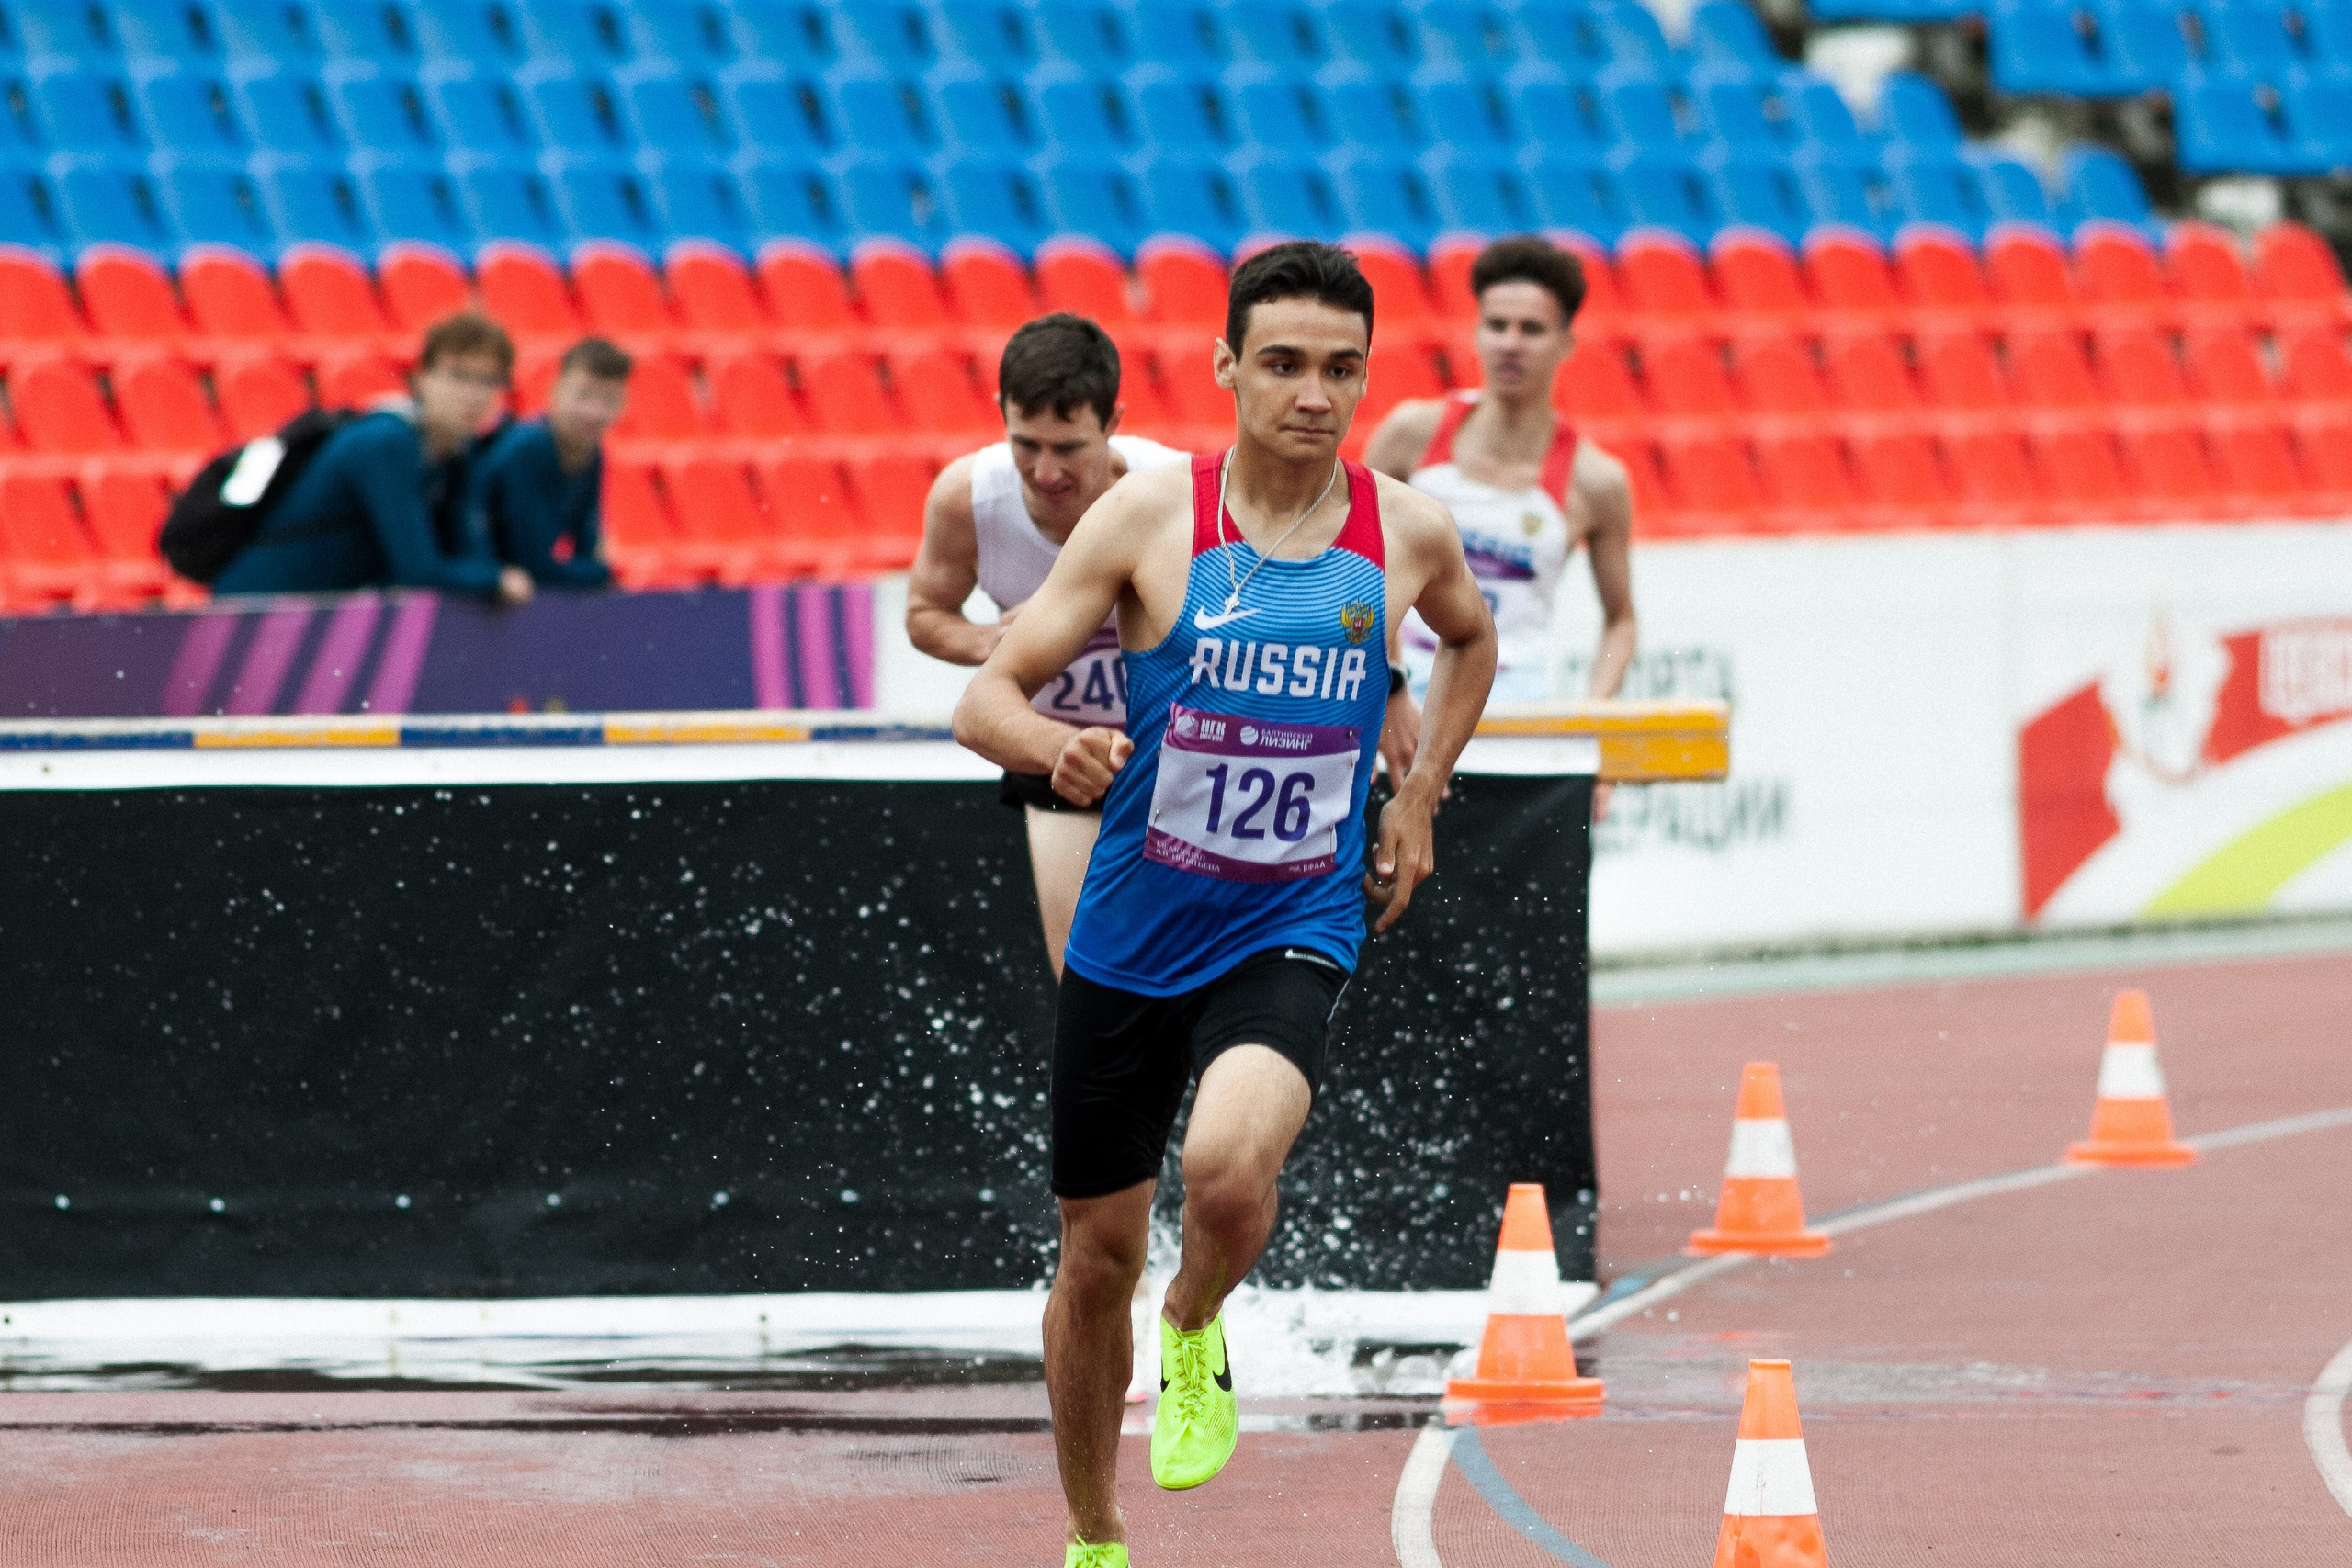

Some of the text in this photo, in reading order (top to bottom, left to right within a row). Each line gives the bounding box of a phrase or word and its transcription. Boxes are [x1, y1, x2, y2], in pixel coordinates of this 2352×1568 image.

[1189, 637, 1367, 702] RUSSIA
[1260, 735, 1312, 750] ЛИЗИНГ
[1204, 763, 1316, 842] 126
